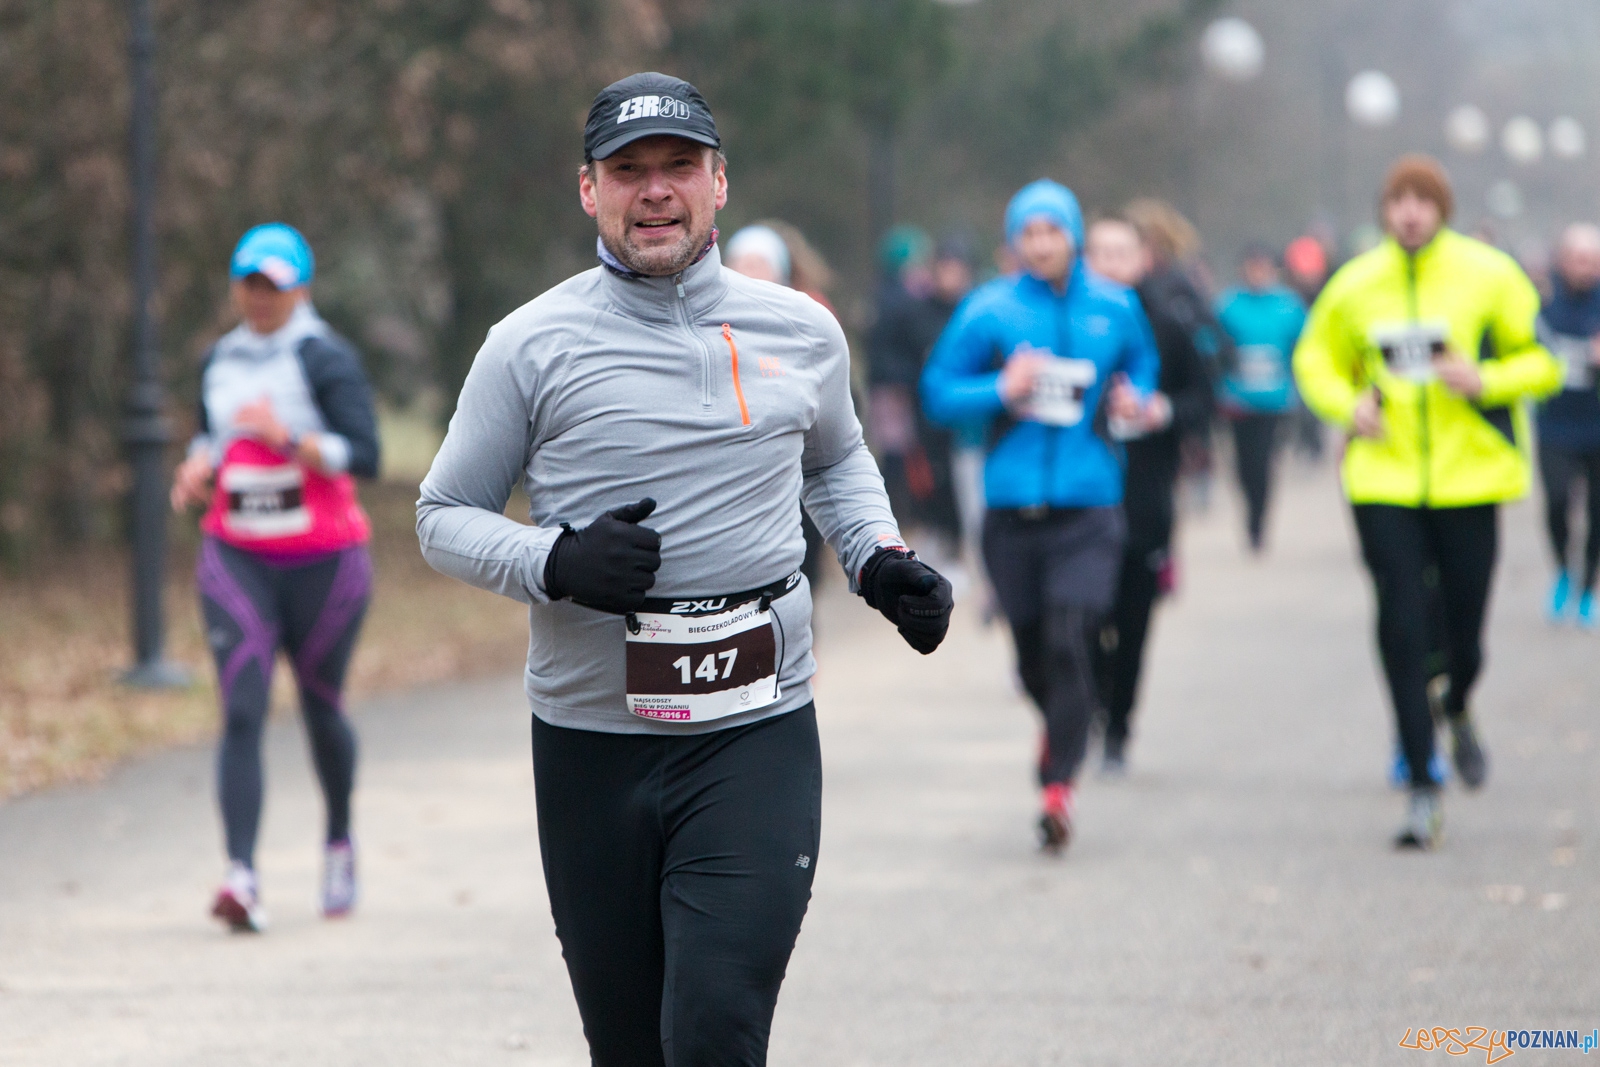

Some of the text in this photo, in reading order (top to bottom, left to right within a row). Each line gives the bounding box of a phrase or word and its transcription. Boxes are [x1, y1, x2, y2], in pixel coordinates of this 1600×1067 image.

[669, 597, 728, 614] 2XU
[688, 608, 764, 634] BIEGCZEKOLADOWY.P
[672, 647, 738, 685] 147
